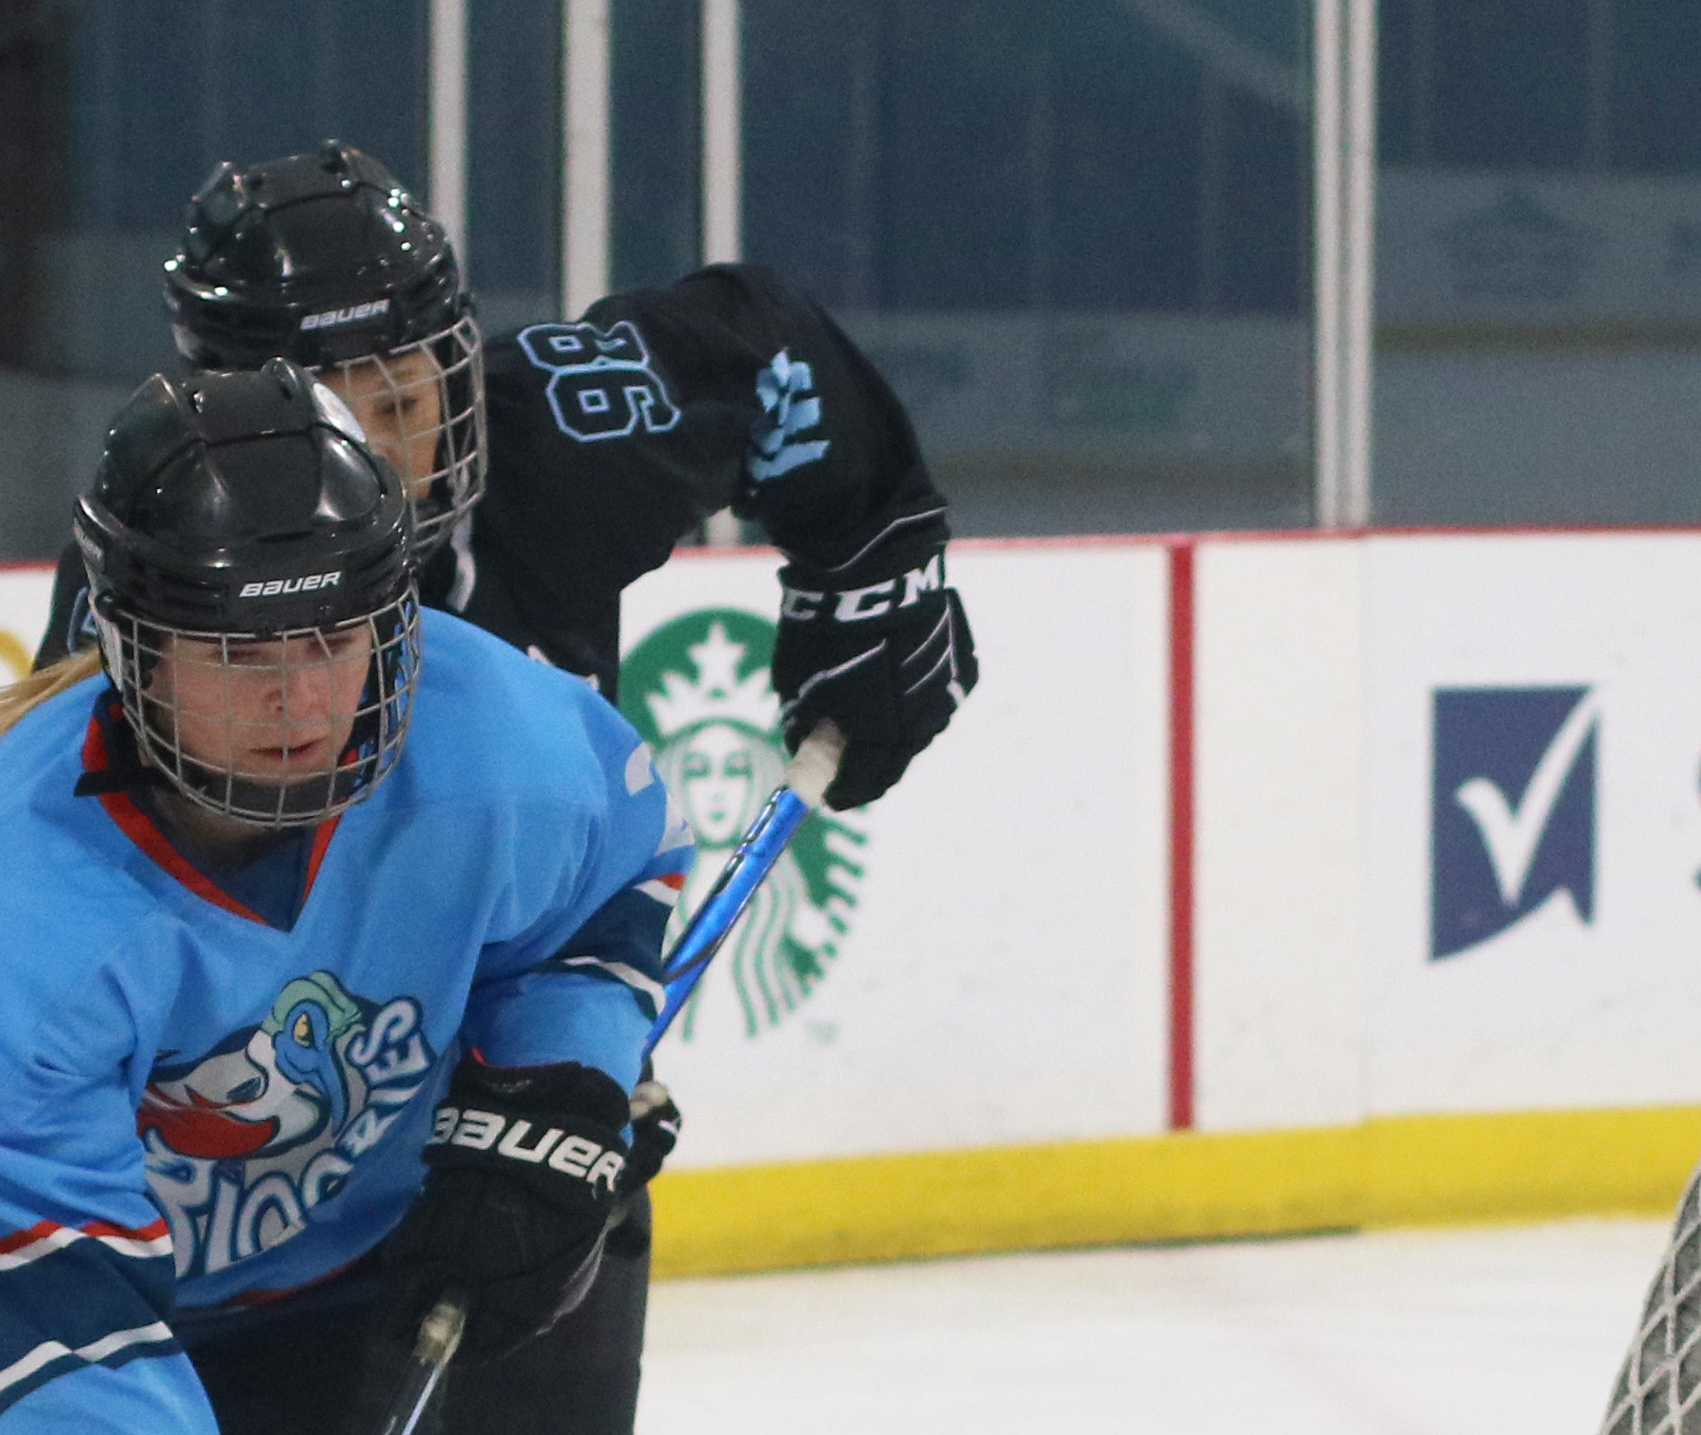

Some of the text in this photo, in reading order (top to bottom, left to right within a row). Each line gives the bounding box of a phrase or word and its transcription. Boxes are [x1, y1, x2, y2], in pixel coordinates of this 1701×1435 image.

[300, 299, 391, 331] BAUER
[239, 569, 343, 599] BAUER
[783, 552, 946, 623] CCM
[429, 1106, 626, 1192] BAUER
